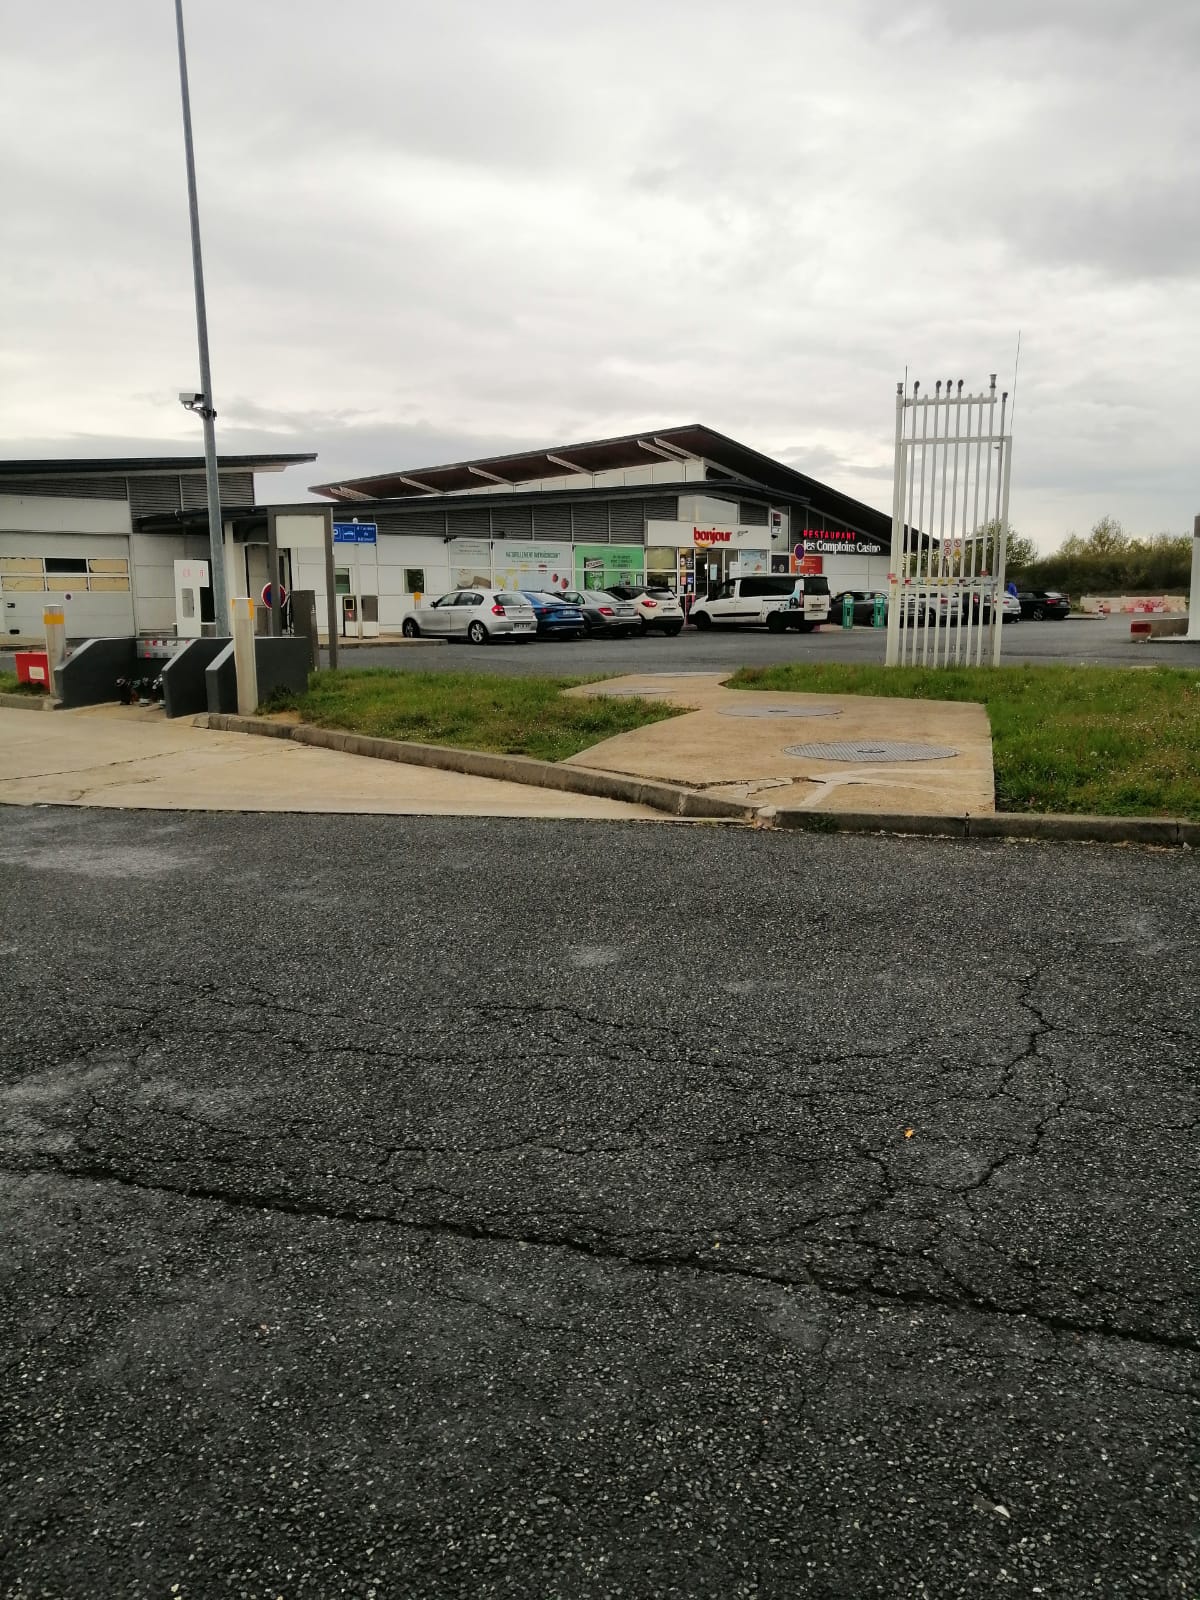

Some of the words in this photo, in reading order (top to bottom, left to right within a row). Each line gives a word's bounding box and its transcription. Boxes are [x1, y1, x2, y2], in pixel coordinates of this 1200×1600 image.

[693, 526, 733, 544] bonjour
[803, 529, 856, 541] RESTAURANT
[817, 540, 856, 555] Comptoirs
[856, 542, 881, 553] Casino
